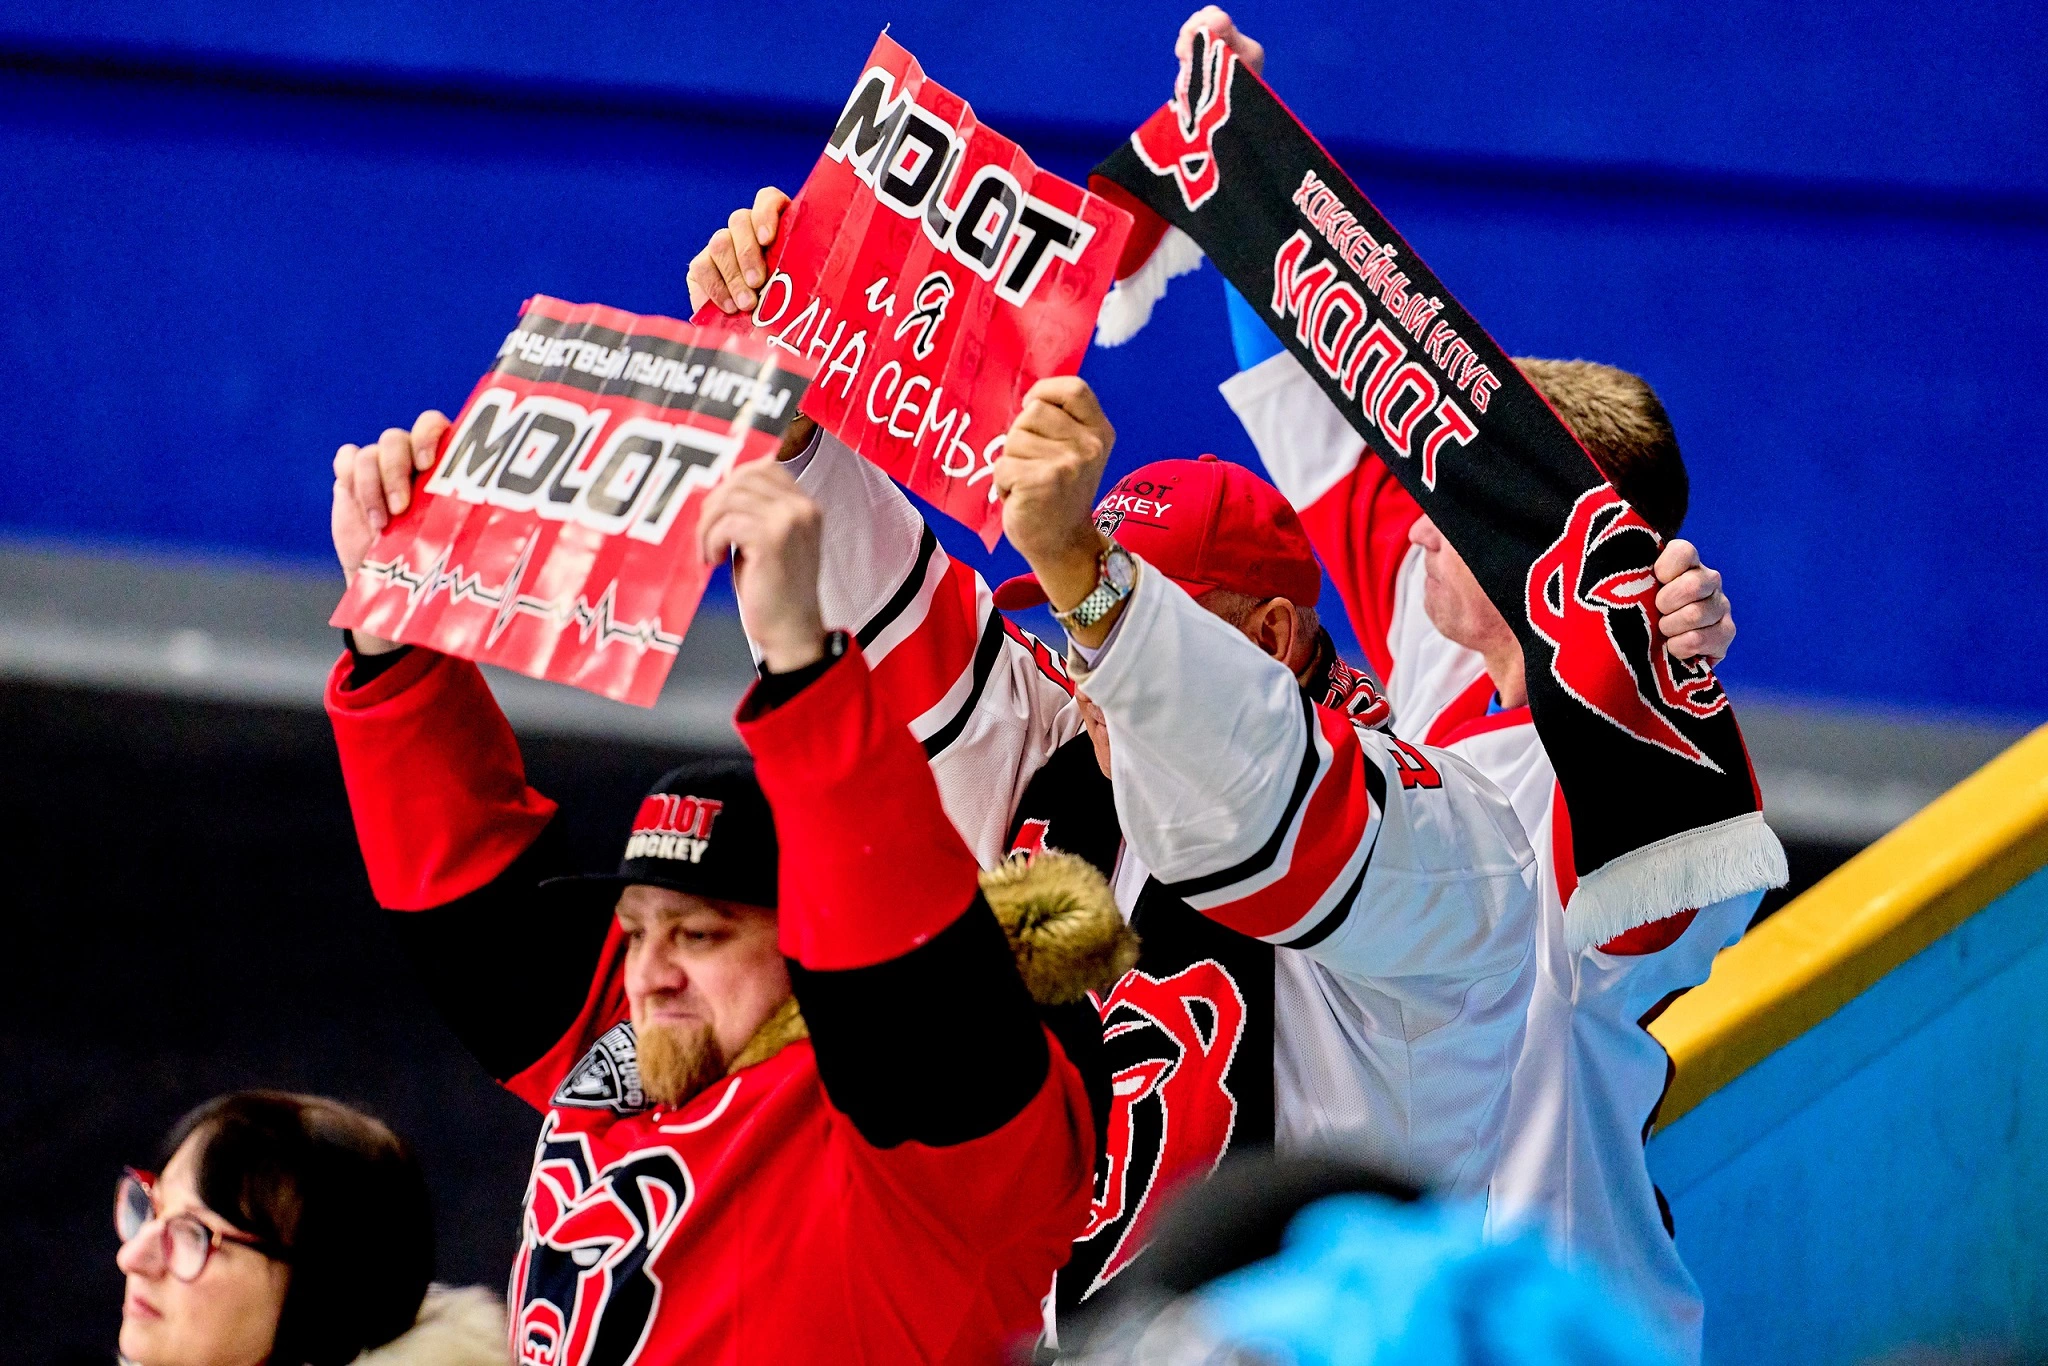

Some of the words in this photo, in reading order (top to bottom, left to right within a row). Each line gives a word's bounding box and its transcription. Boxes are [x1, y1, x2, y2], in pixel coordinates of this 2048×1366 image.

[825, 66, 1095, 307] MOLOT
[752, 268, 867, 399] ОДНА
[894, 270, 954, 357] Я
[1271, 229, 1478, 491] МОЛОТ
[1292, 169, 1444, 342] ХОККЕЙНЫЙ
[1424, 320, 1501, 413] КЛУБ
[424, 387, 743, 545] MOLOT
[1095, 494, 1173, 518] OCKEY
